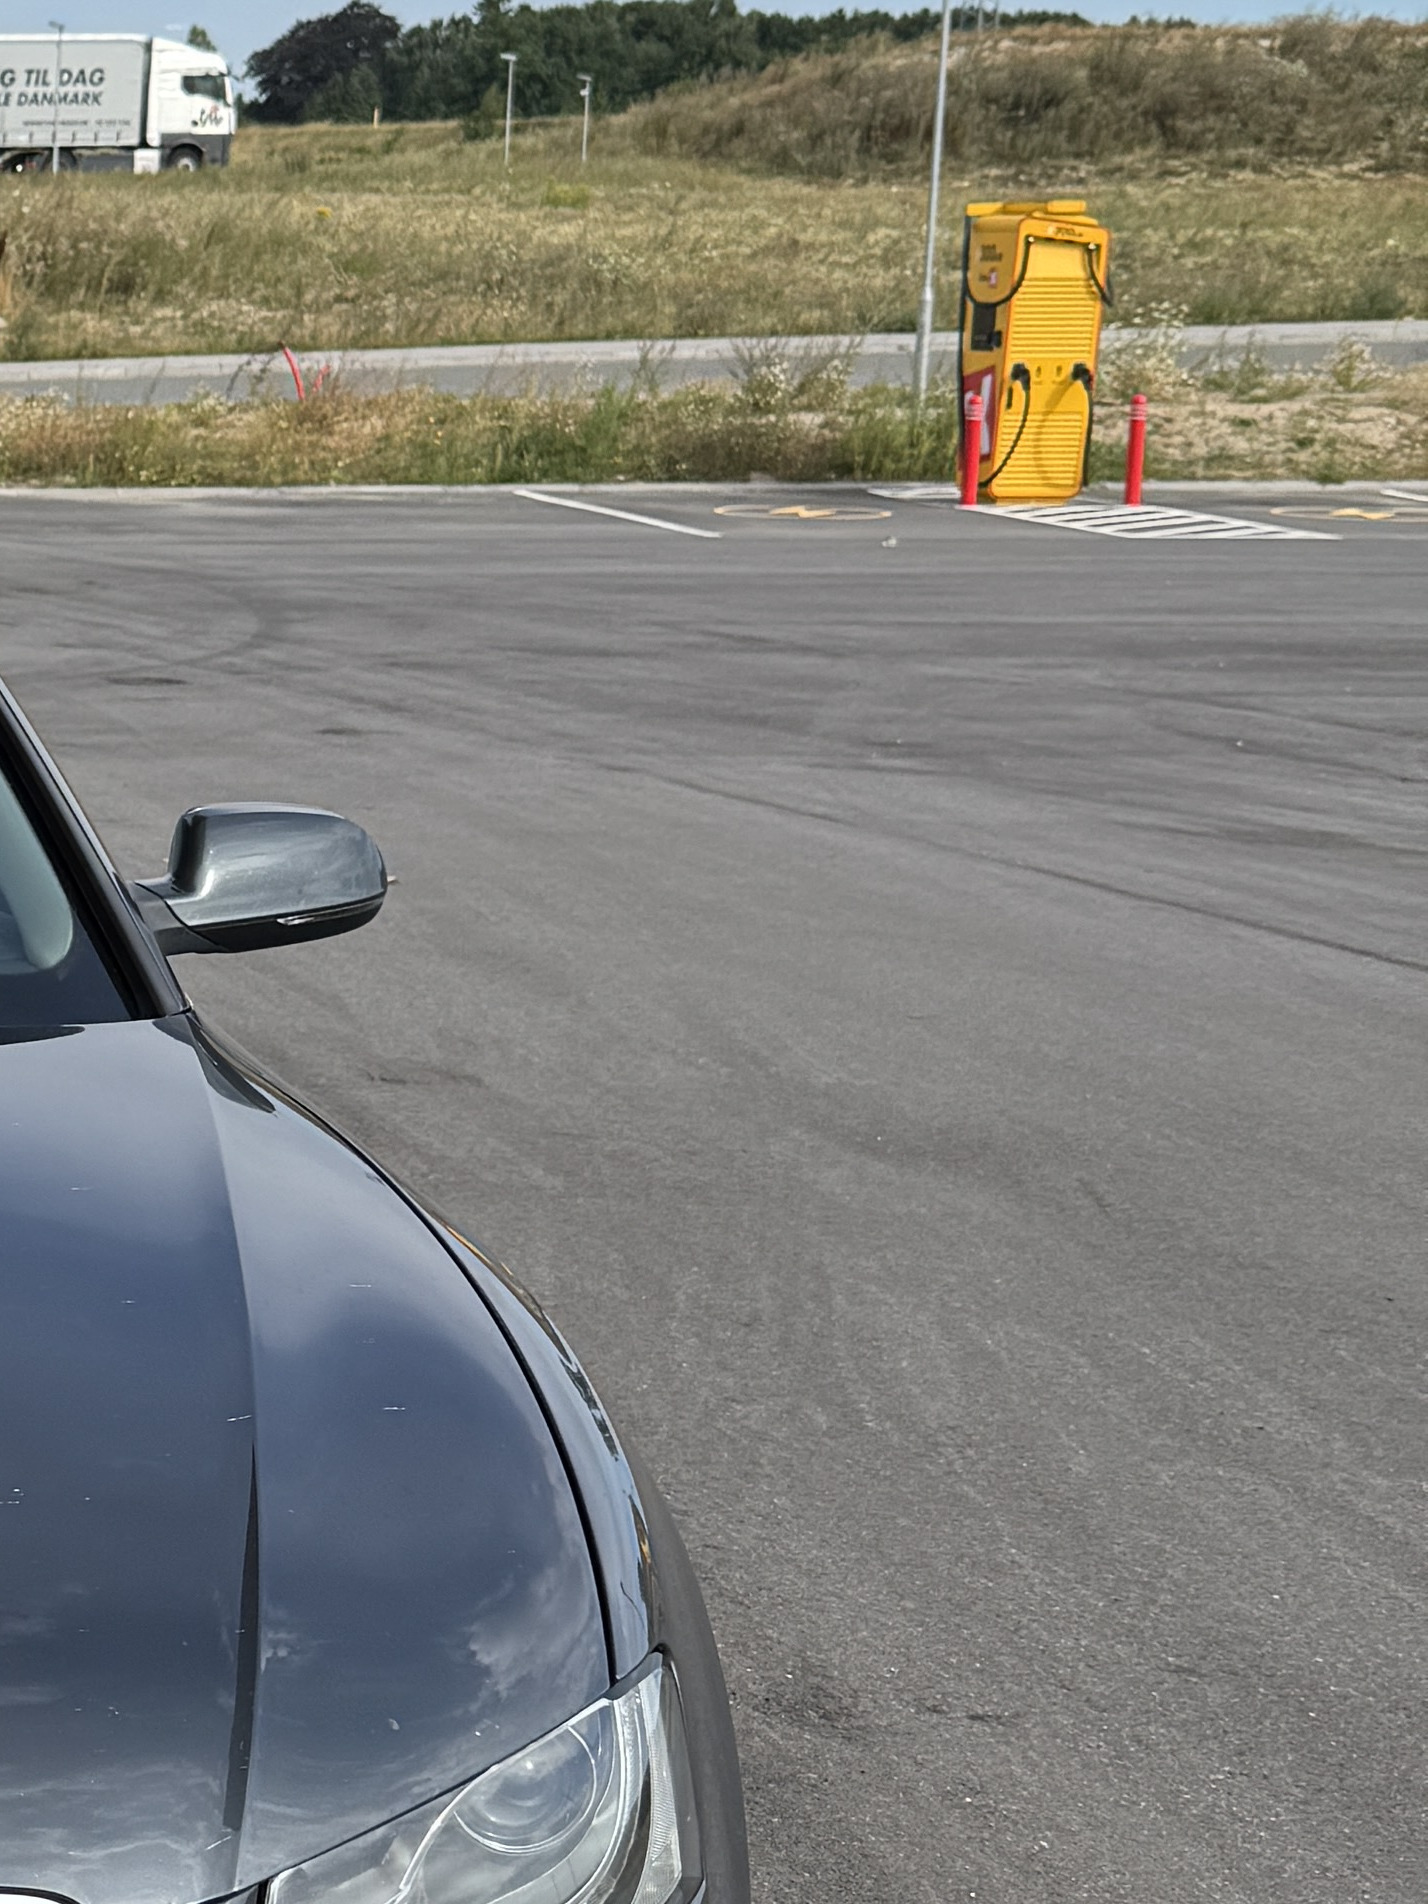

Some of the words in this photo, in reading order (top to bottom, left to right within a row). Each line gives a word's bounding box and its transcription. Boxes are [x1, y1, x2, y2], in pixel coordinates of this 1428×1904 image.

[24, 68, 52, 88] TIL
[58, 68, 105, 88] DAG
[16, 91, 104, 107] DANMARK
